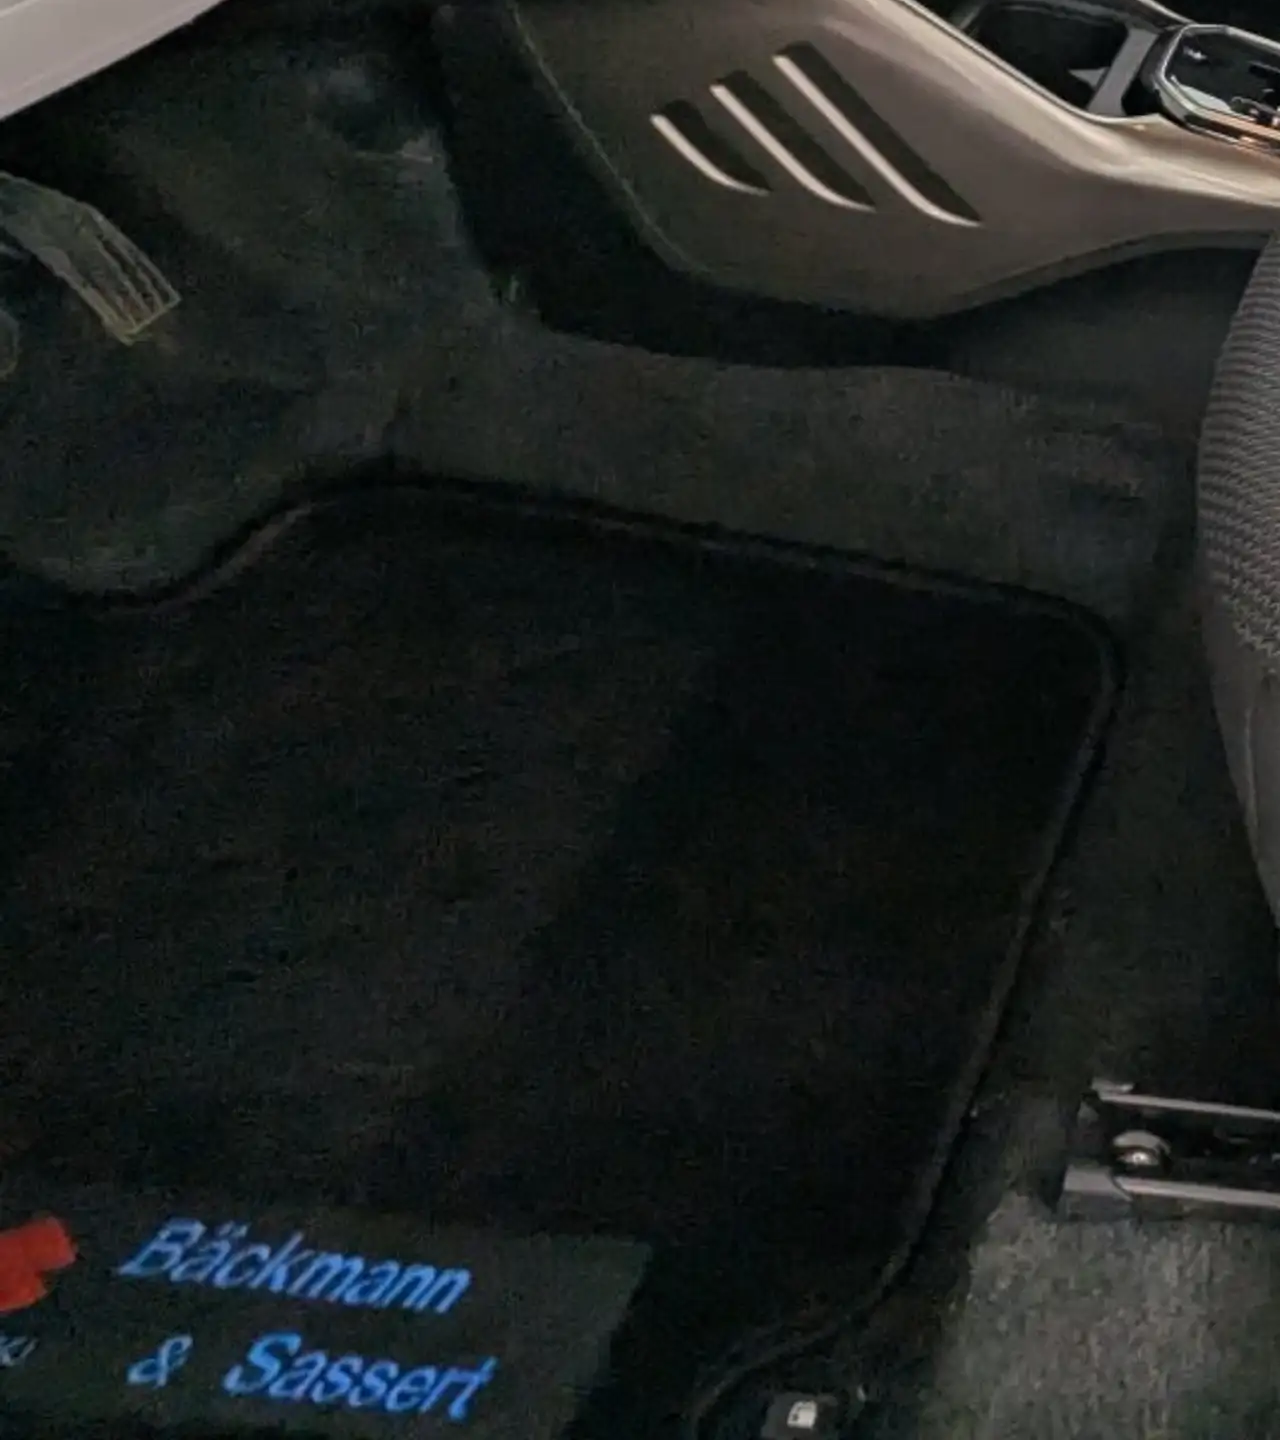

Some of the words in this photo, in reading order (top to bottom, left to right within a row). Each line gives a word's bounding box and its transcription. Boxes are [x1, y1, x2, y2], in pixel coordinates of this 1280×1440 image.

[118, 1216, 472, 1314] Bäckmann
[127, 1333, 194, 1388] &
[223, 1330, 498, 1421] Sassert
